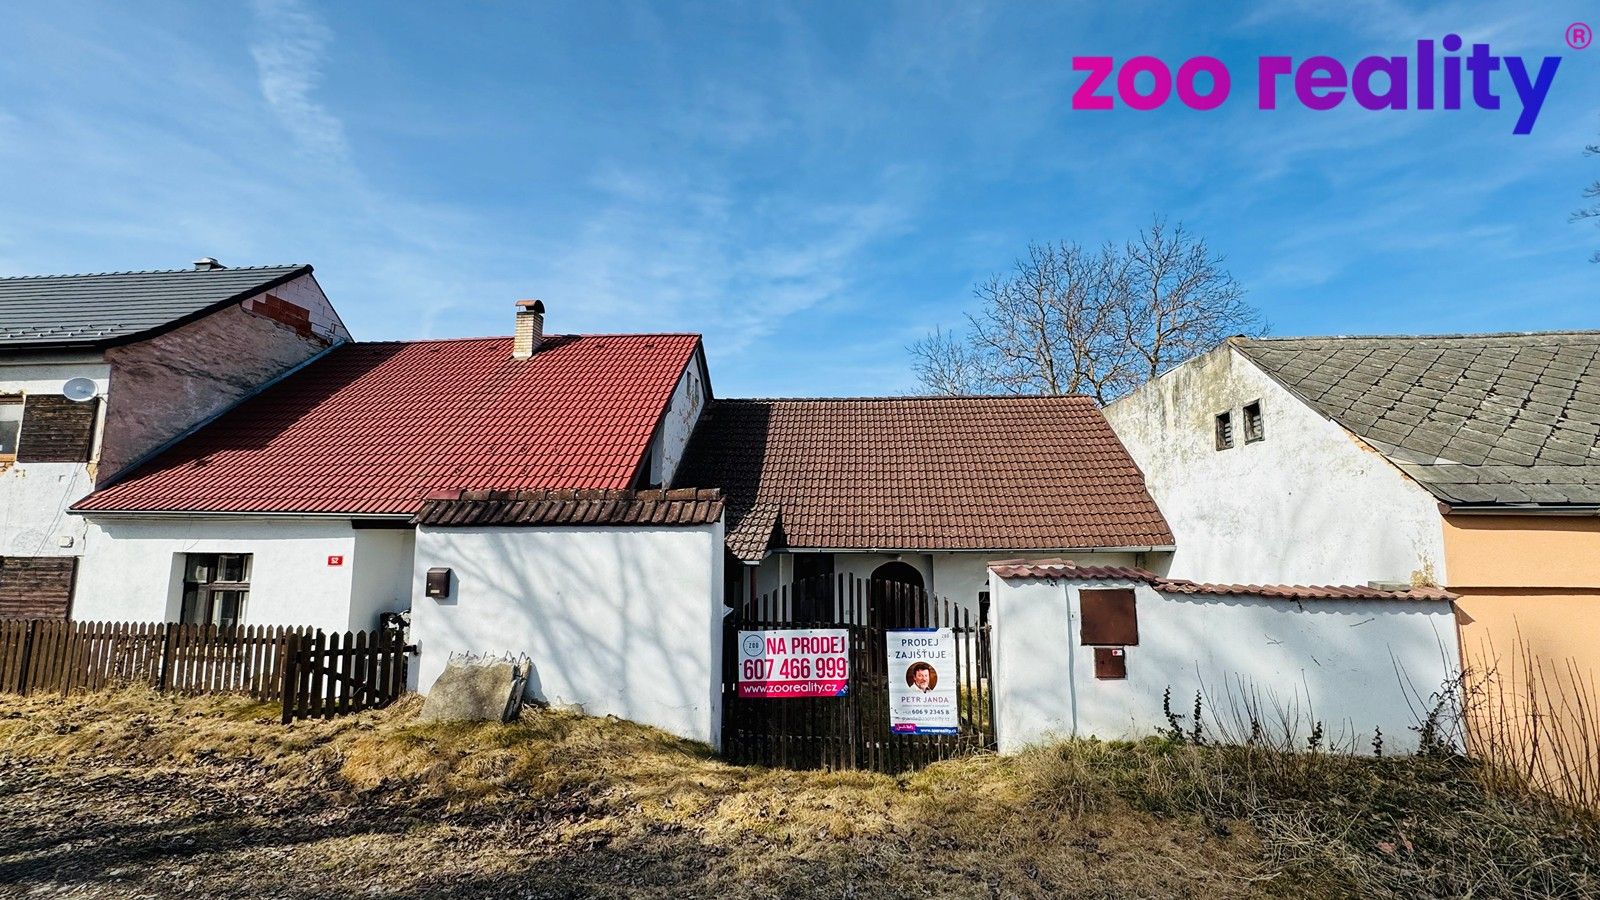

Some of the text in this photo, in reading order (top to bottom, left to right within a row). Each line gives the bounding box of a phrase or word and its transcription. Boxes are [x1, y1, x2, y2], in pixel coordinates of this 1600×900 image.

[766, 636, 846, 655] NA PRODEJ
[901, 638, 939, 647] PRODEJ
[895, 648, 947, 659] ZAJIŠŤUJE
[743, 656, 847, 680] 607 466 999
[743, 682, 838, 694] www.zooreality.cz
